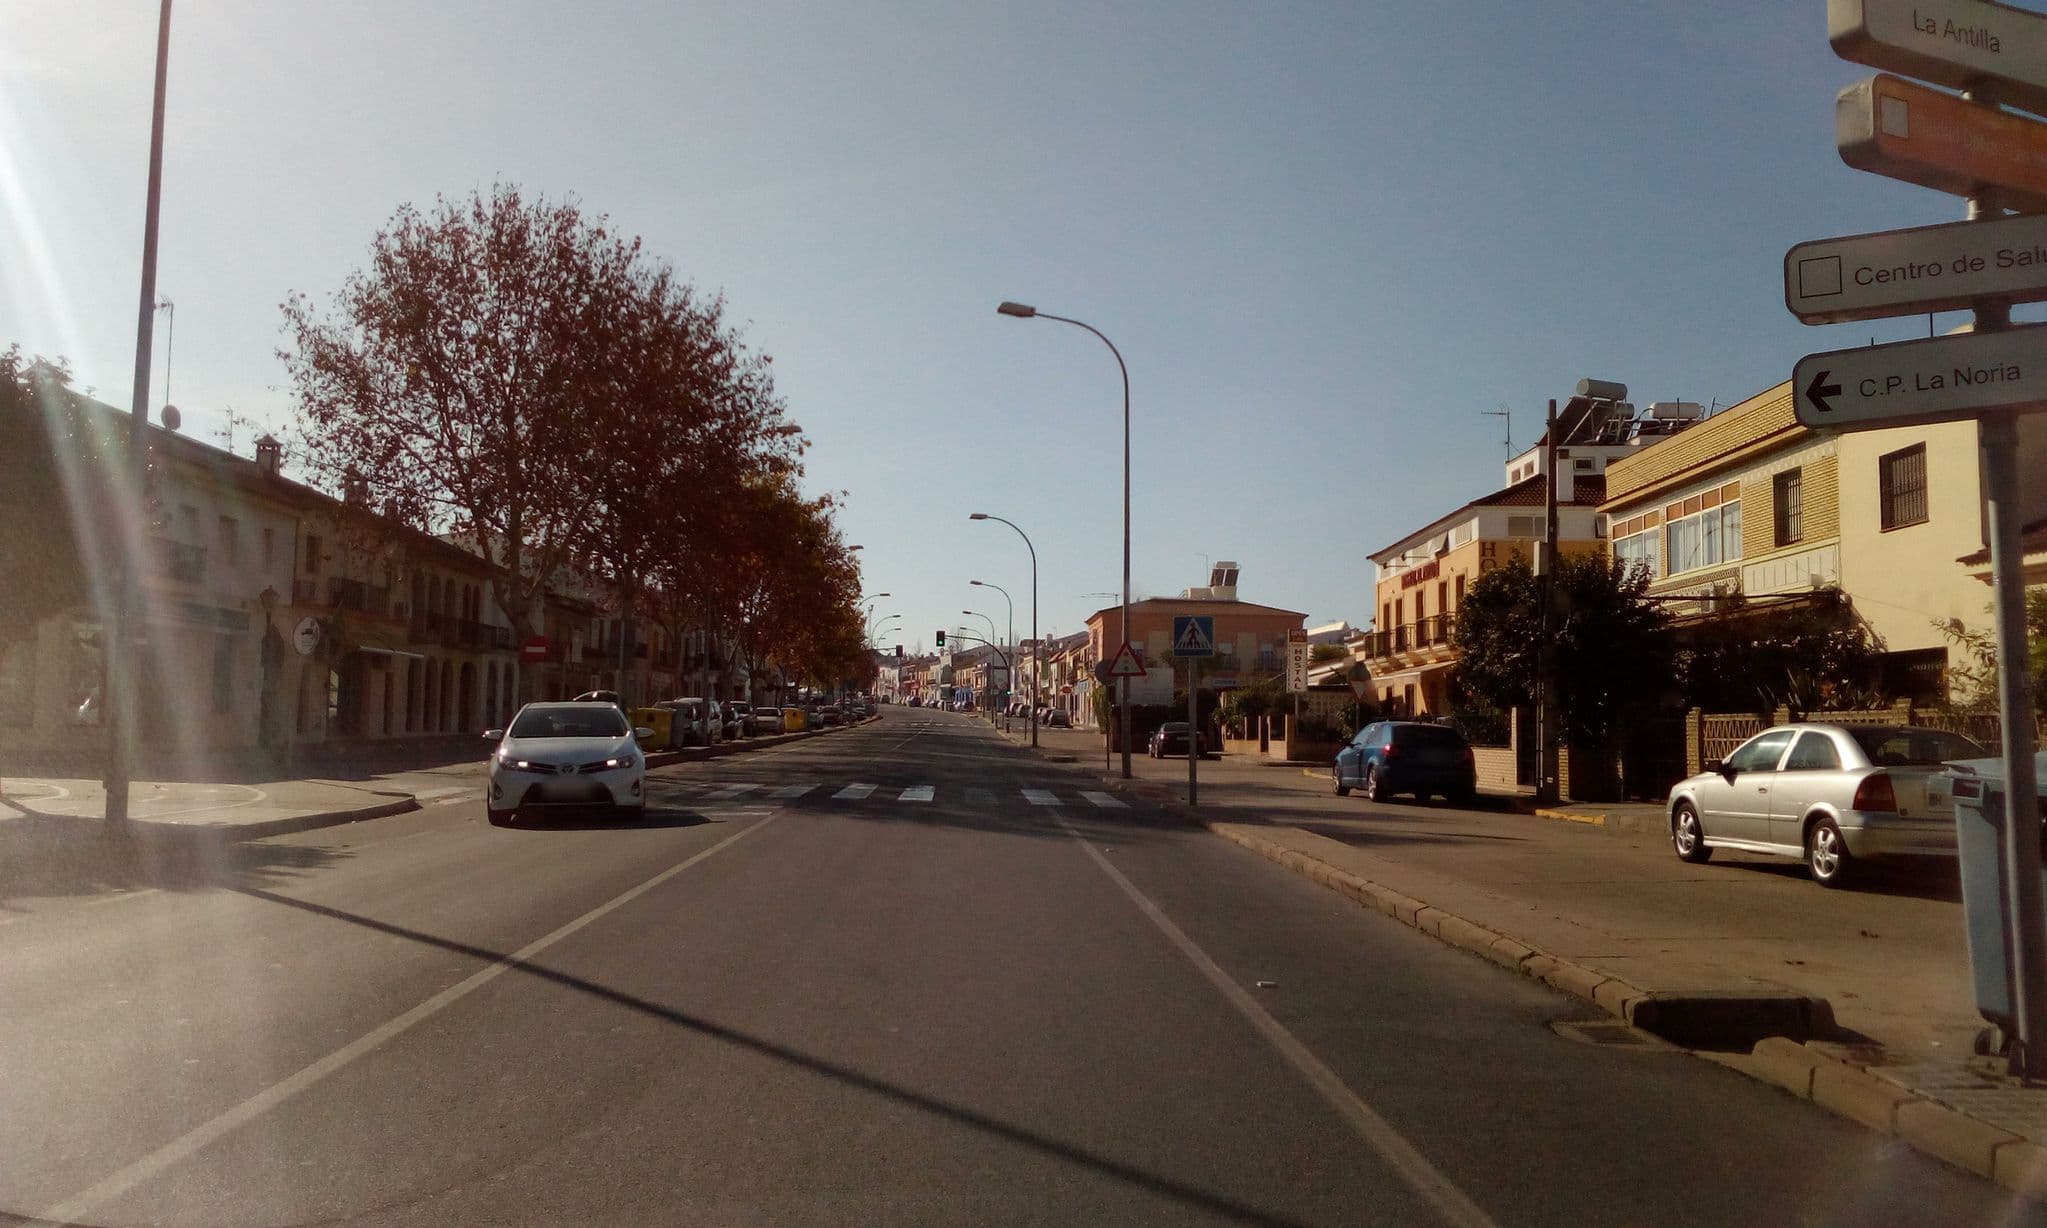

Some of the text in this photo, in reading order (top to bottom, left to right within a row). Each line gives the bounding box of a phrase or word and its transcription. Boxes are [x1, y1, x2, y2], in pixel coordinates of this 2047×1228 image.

[1913, 8, 2001, 54] La Antilla
[1854, 261, 1943, 286] Centro
[1952, 254, 1985, 274] de
[1859, 362, 2022, 398] C.P. La Noria
[1294, 648, 1303, 690] HOSTAL
